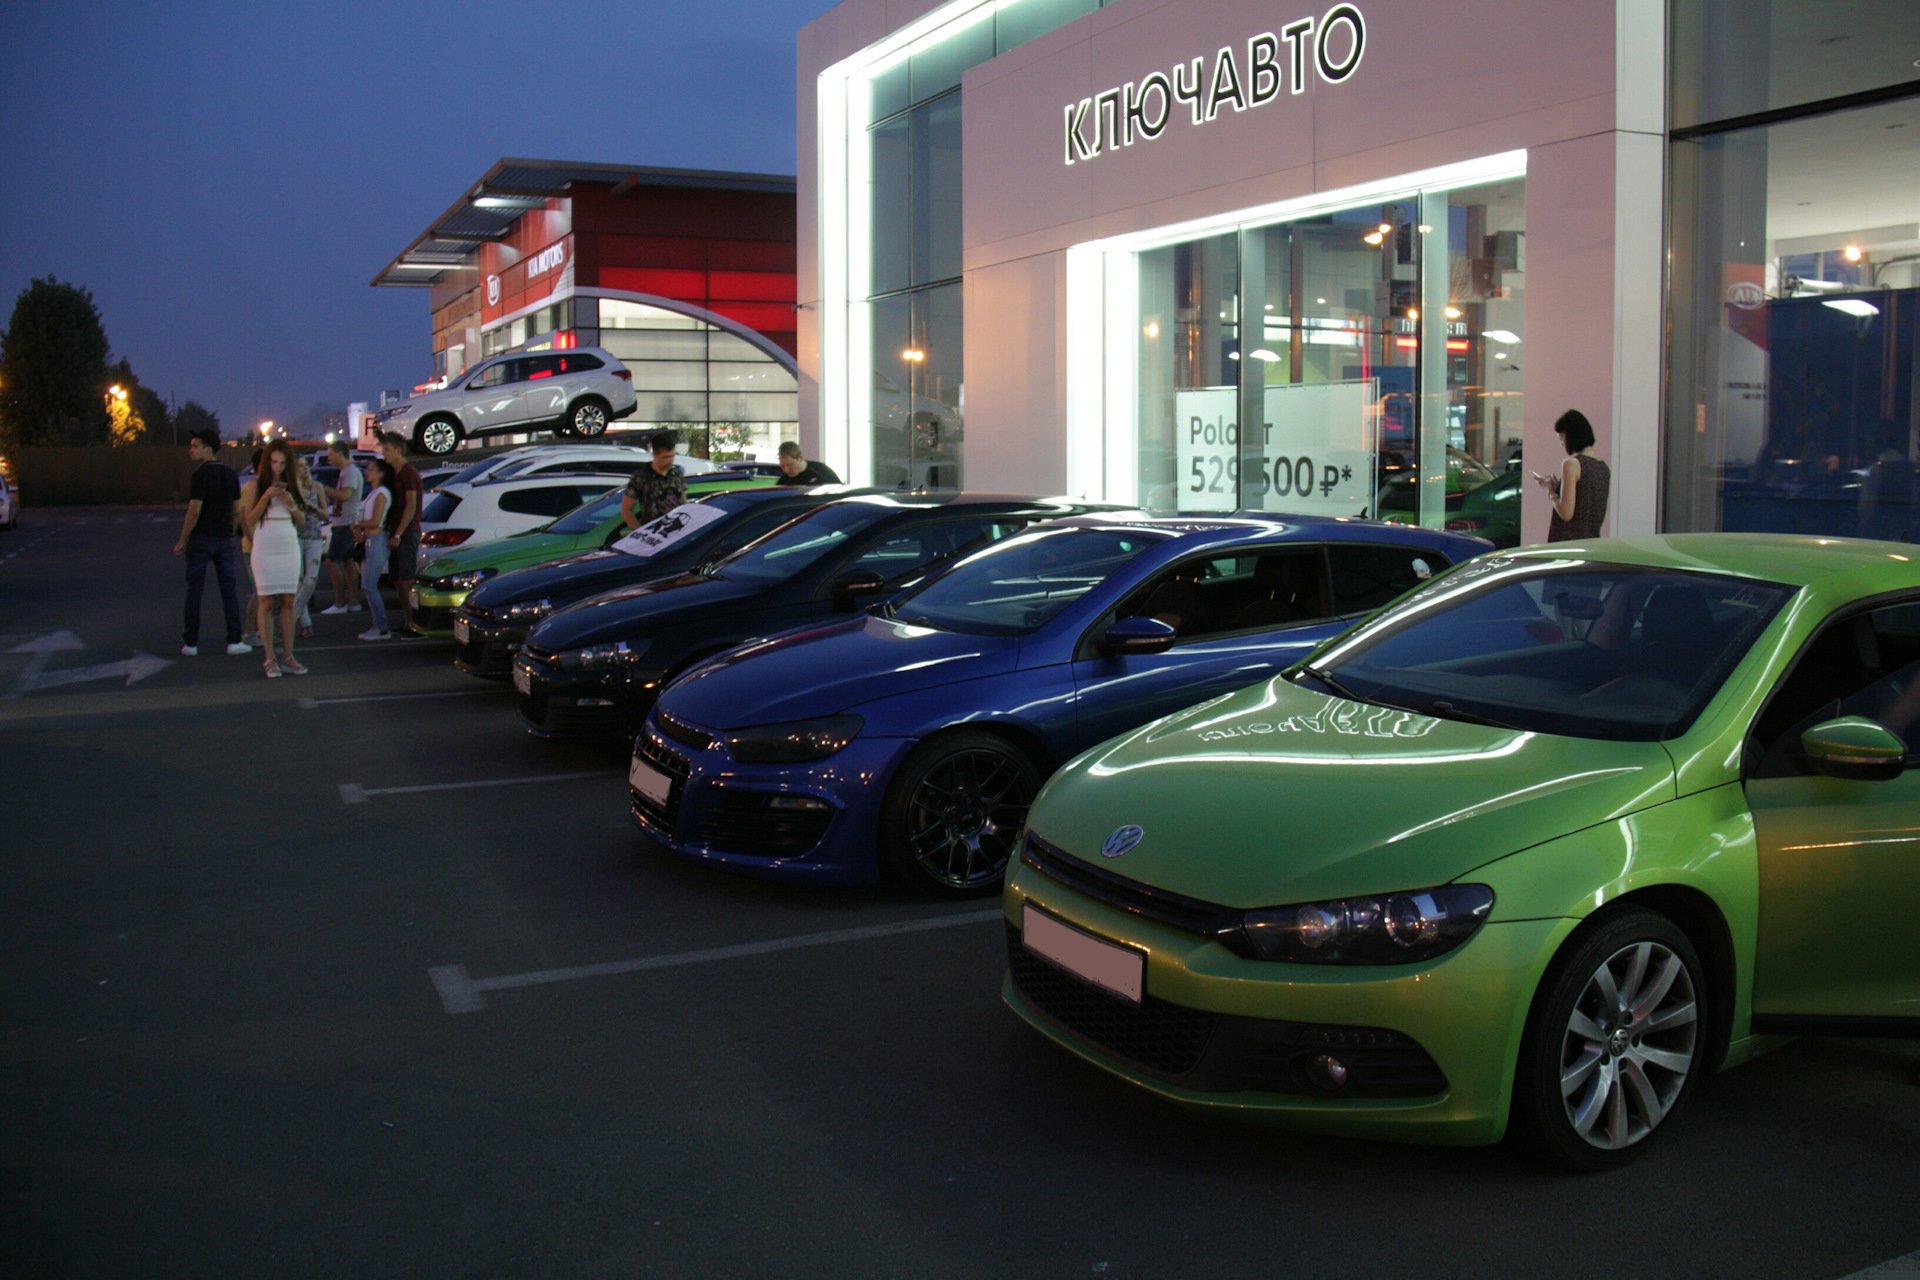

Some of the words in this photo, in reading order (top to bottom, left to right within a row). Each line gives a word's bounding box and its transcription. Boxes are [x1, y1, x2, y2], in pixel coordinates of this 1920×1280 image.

[1064, 3, 1366, 165] КЛЮЧАВТО
[539, 241, 563, 272] MOTORS
[1190, 415, 1237, 445] Polo
[1190, 456, 1237, 493] 529
